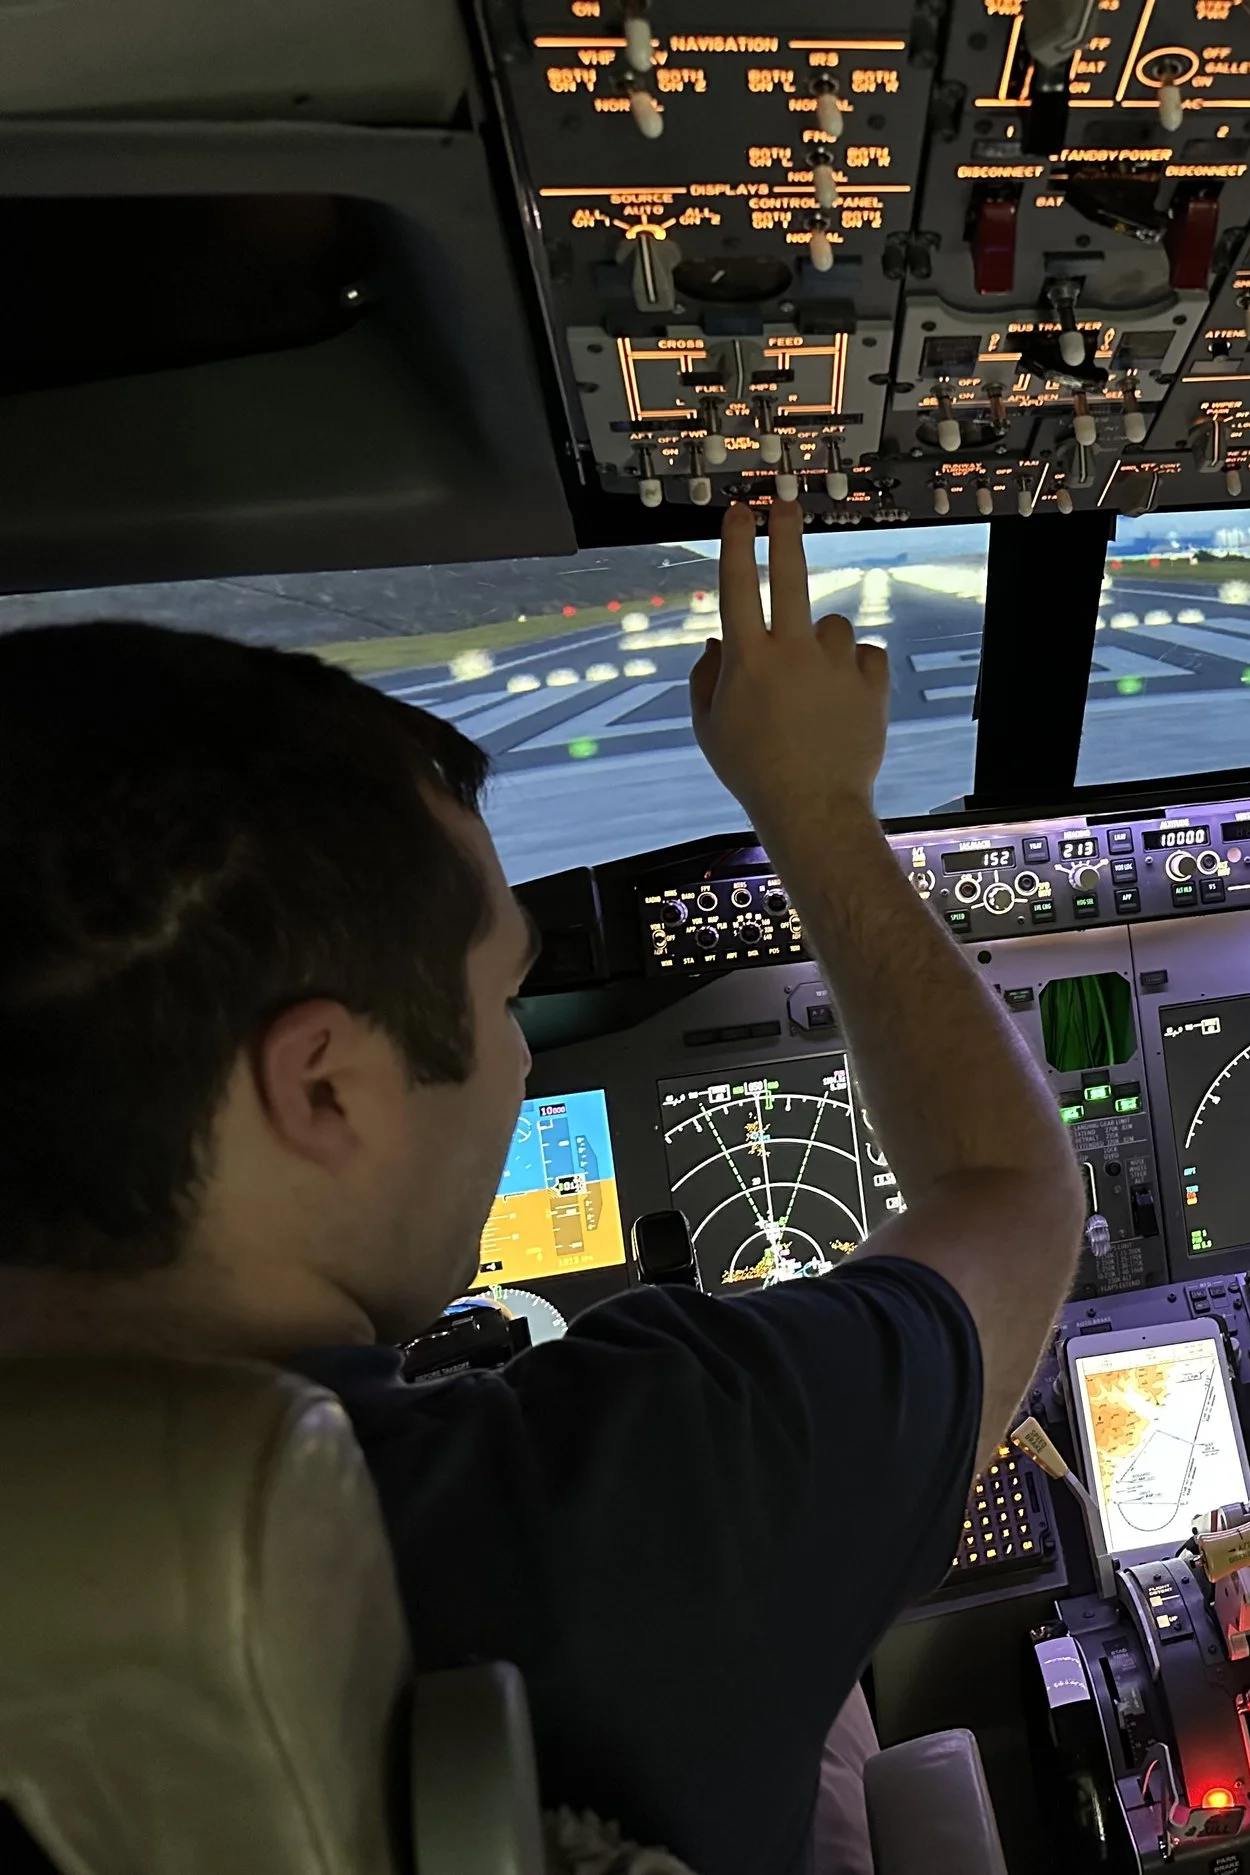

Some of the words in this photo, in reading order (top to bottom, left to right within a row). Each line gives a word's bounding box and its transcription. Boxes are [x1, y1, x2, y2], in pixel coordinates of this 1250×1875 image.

[670, 36, 779, 53] NAVIGATION
[578, 49, 616, 65] VHF
[808, 51, 840, 67] IRS
[1118, 149, 1173, 161] POWER
[957, 166, 1044, 179] DISCONNECT
[1165, 164, 1248, 177] DISCONNECT
[689, 183, 769, 196] DISPLAYS
[610, 193, 674, 205] SOURCE
[749, 197, 821, 209] CONTROL
[1036, 197, 1065, 208] BAT
[623, 204, 665, 216] AUTO
[1008, 322, 1035, 333] BUS
[1038, 322, 1102, 332] TRAFER
[658, 339, 704, 349] CROSS
[768, 337, 804, 347] FEED
[958, 378, 981, 387] OFF
[695, 385, 727, 393] FUEL
[1211, 402, 1243, 410] WIPER
[629, 432, 653, 440] AFT
[681, 431, 708, 439] FWD
[662, 448, 679, 456] ON
[800, 443, 816, 451] ON
[1160, 829, 1205, 847] 10000
[1062, 840, 1094, 858] 213
[983, 851, 1010, 866] 152
[1024, 1433, 1043, 1453] BRAKE
[1028, 1429, 1048, 1450] SPEED
[1216, 1855, 1237, 1865] PARK
[1214, 1861, 1240, 1873] BRAKE
